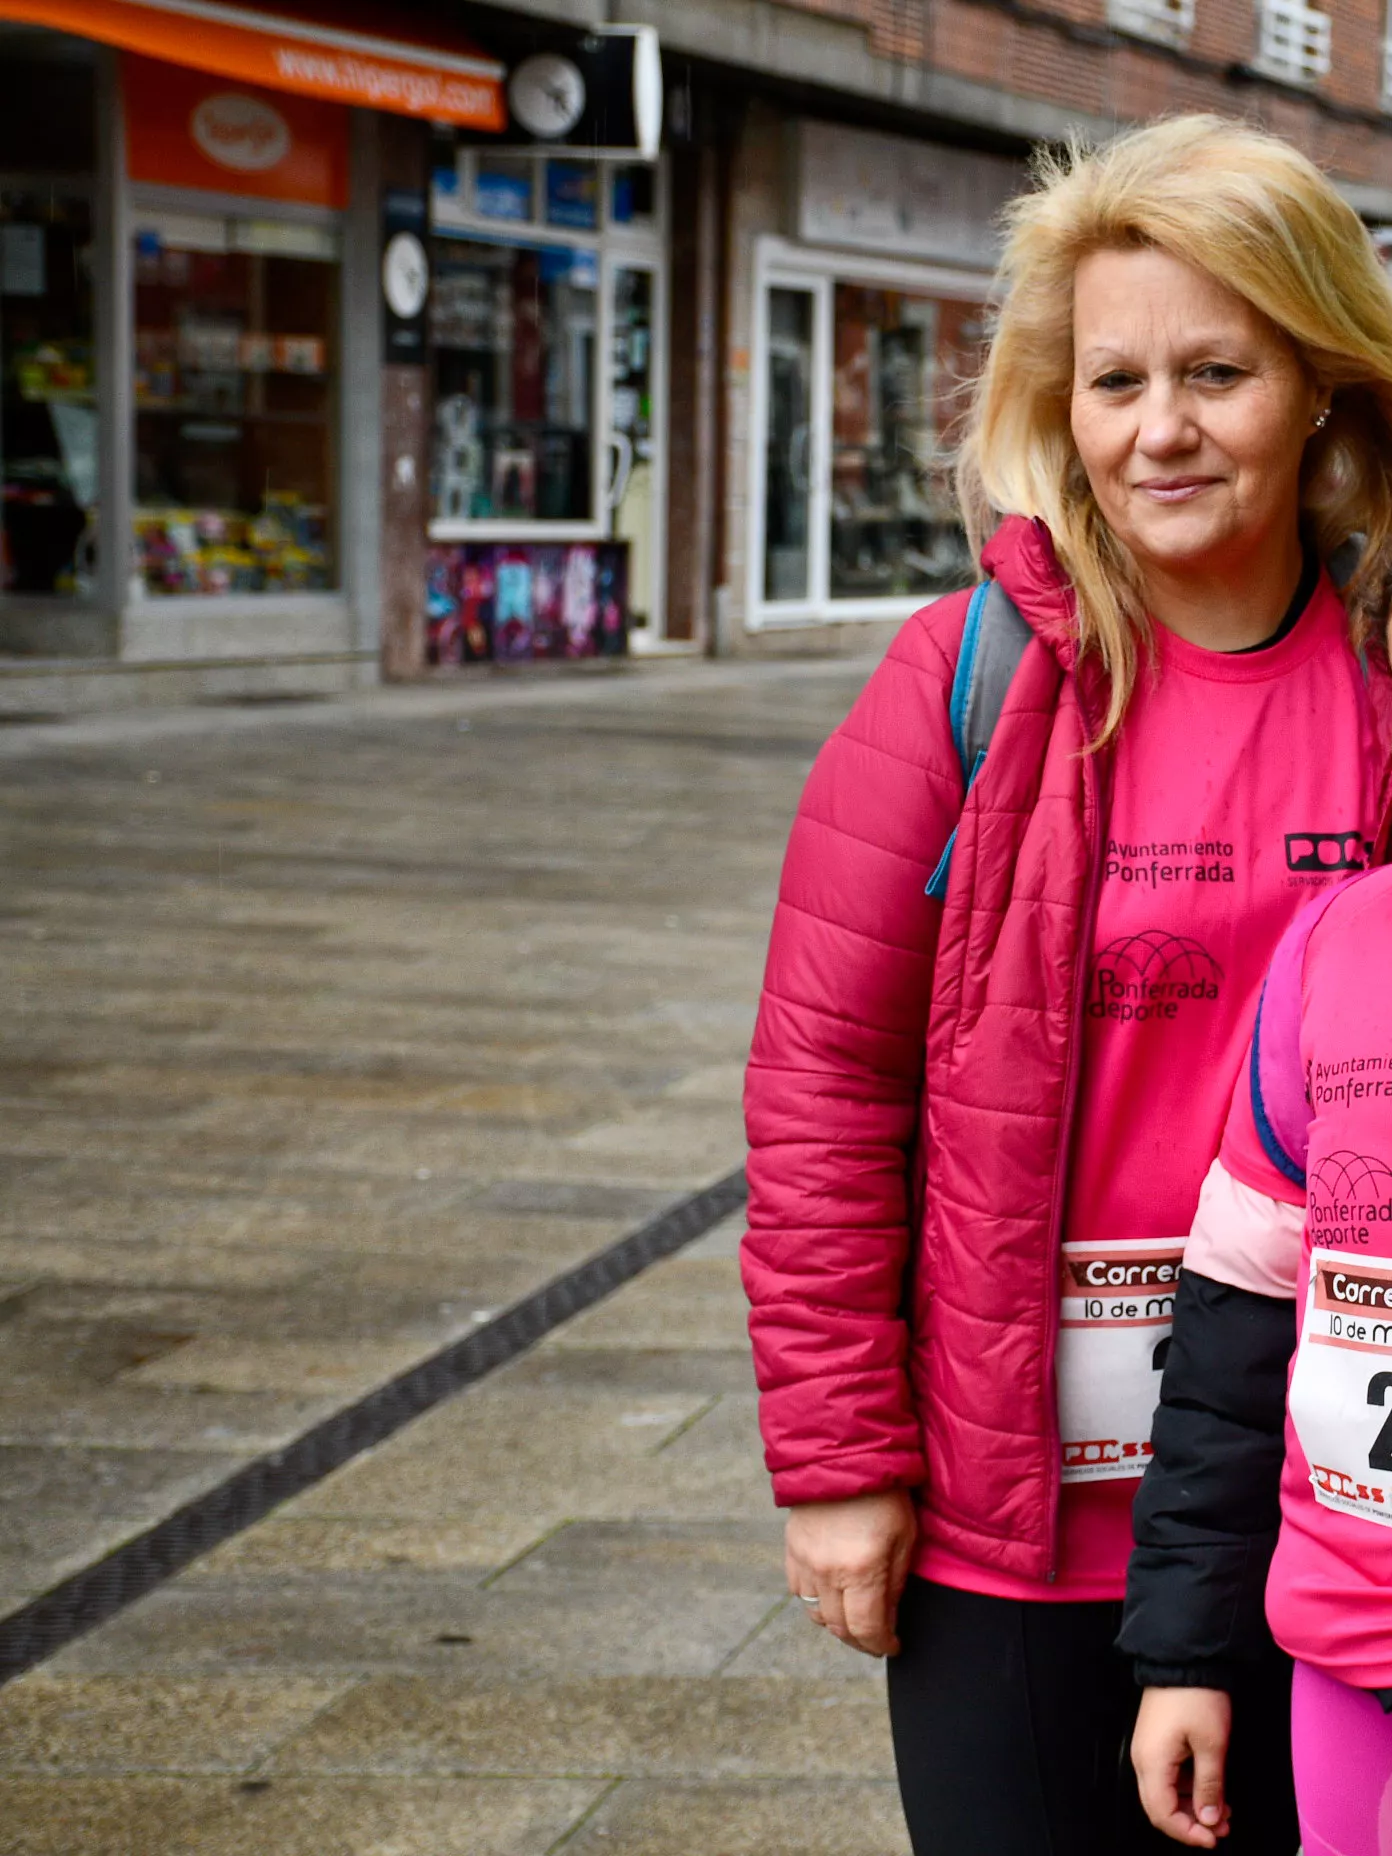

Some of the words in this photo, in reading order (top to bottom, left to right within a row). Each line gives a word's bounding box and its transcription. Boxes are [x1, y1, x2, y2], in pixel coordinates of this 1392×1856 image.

[1107, 840, 1234, 859] Ayuntamiento
[1105, 861, 1235, 890] Ponferrada
[1098, 969, 1219, 1001] Ponferrada
[1088, 1001, 1179, 1025] deporte
[1086, 1260, 1183, 1286] Carrer
[1085, 1298, 1104, 1318] 10
[1110, 1301, 1138, 1318] de
[1329, 1313, 1342, 1336] 10
[1346, 1321, 1367, 1341] de
